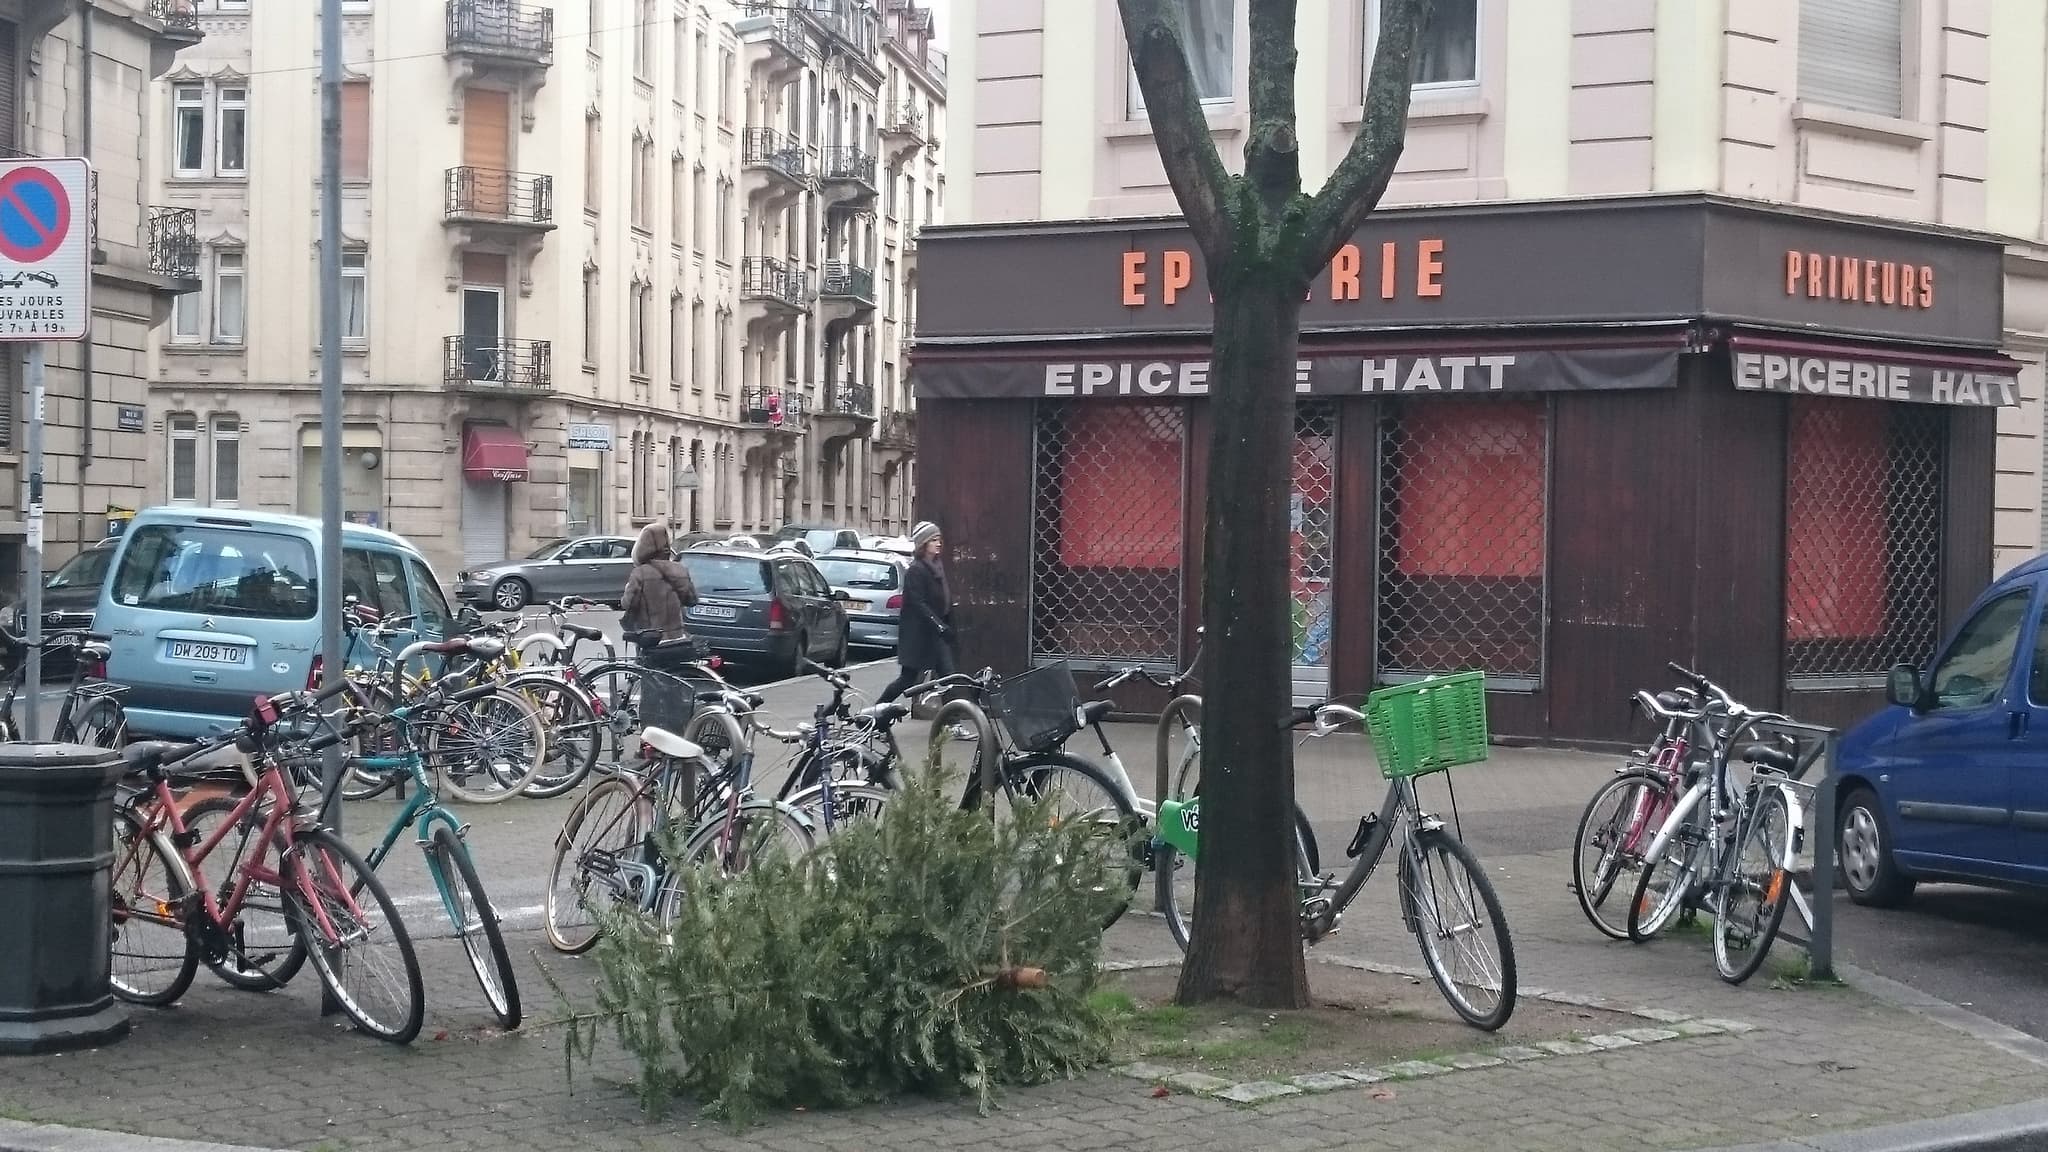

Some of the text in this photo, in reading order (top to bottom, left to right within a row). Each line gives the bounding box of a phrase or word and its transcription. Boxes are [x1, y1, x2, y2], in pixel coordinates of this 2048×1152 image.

[1122, 239, 1444, 306] EPRIE
[1785, 250, 1934, 309] PRIMEURS
[0, 296, 63, 306] ES JOURS
[0, 309, 64, 320] UVRABLES
[1045, 356, 1515, 395] EPICEE HATT
[1736, 352, 2018, 406] EPICERIE HATT
[174, 643, 238, 661] DW 209 TQ
